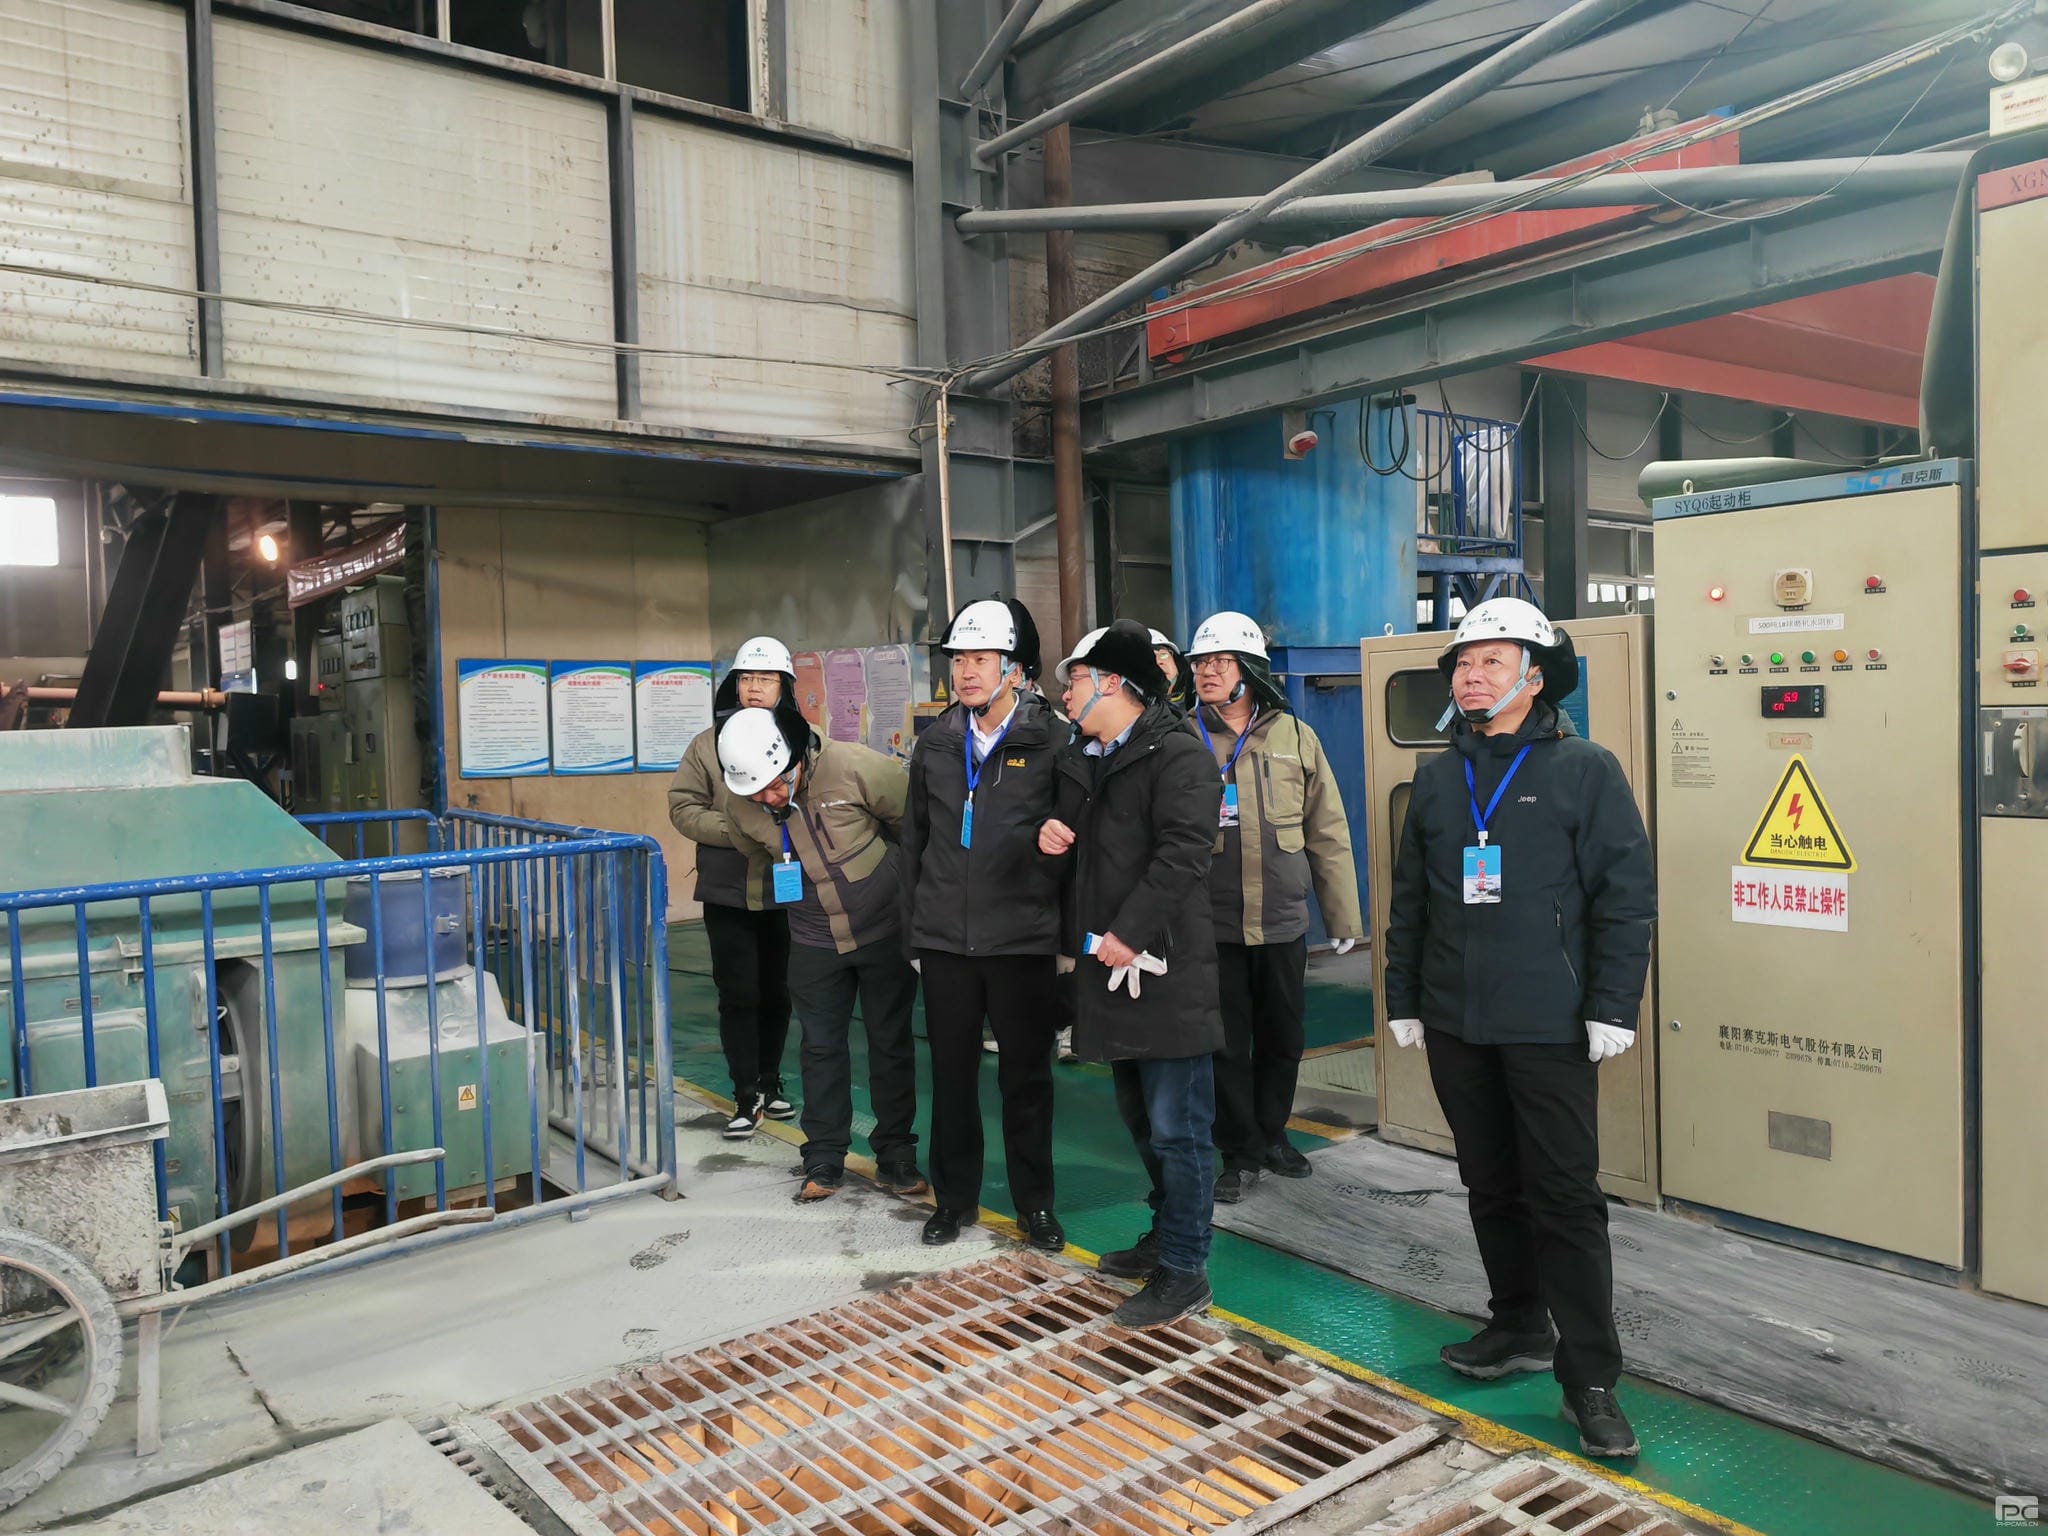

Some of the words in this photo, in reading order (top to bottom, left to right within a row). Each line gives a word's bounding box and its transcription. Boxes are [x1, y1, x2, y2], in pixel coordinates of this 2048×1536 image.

[1674, 490, 1751, 514] SYQ6起动柜
[1517, 795, 1537, 804] Jeep
[1770, 833, 1828, 851] 当心触电
[1734, 880, 1846, 916] 非工作人员禁止操作
[1719, 1024, 1883, 1063] 襄阳赛克斯电气股份有限公司
